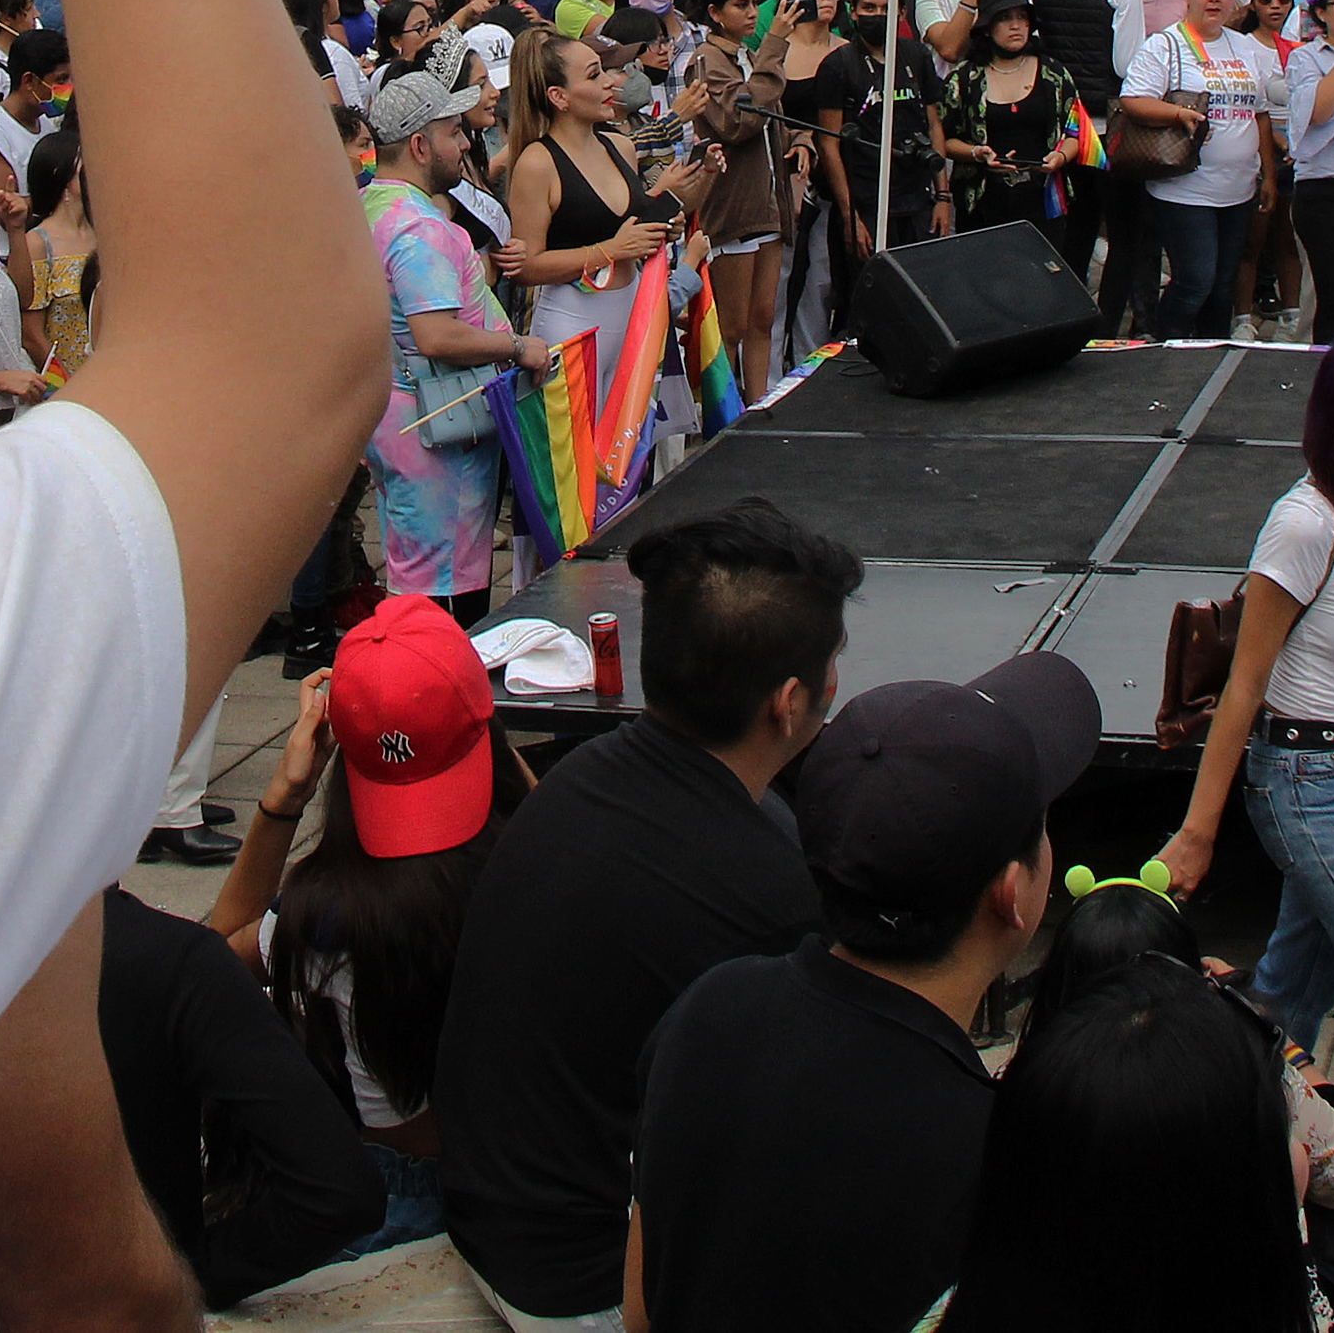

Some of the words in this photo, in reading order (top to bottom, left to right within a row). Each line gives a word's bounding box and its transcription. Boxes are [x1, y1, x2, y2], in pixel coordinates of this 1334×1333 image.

[1206, 80, 1227, 92] GRL
[1232, 81, 1257, 92] PWR
[1208, 94, 1227, 105] GRL
[1233, 94, 1256, 105] PWR
[1207, 108, 1227, 120] GRL
[1232, 109, 1255, 121] PWR
[597, 478, 629, 514] UDIO
[377, 729, 415, 764] NY
